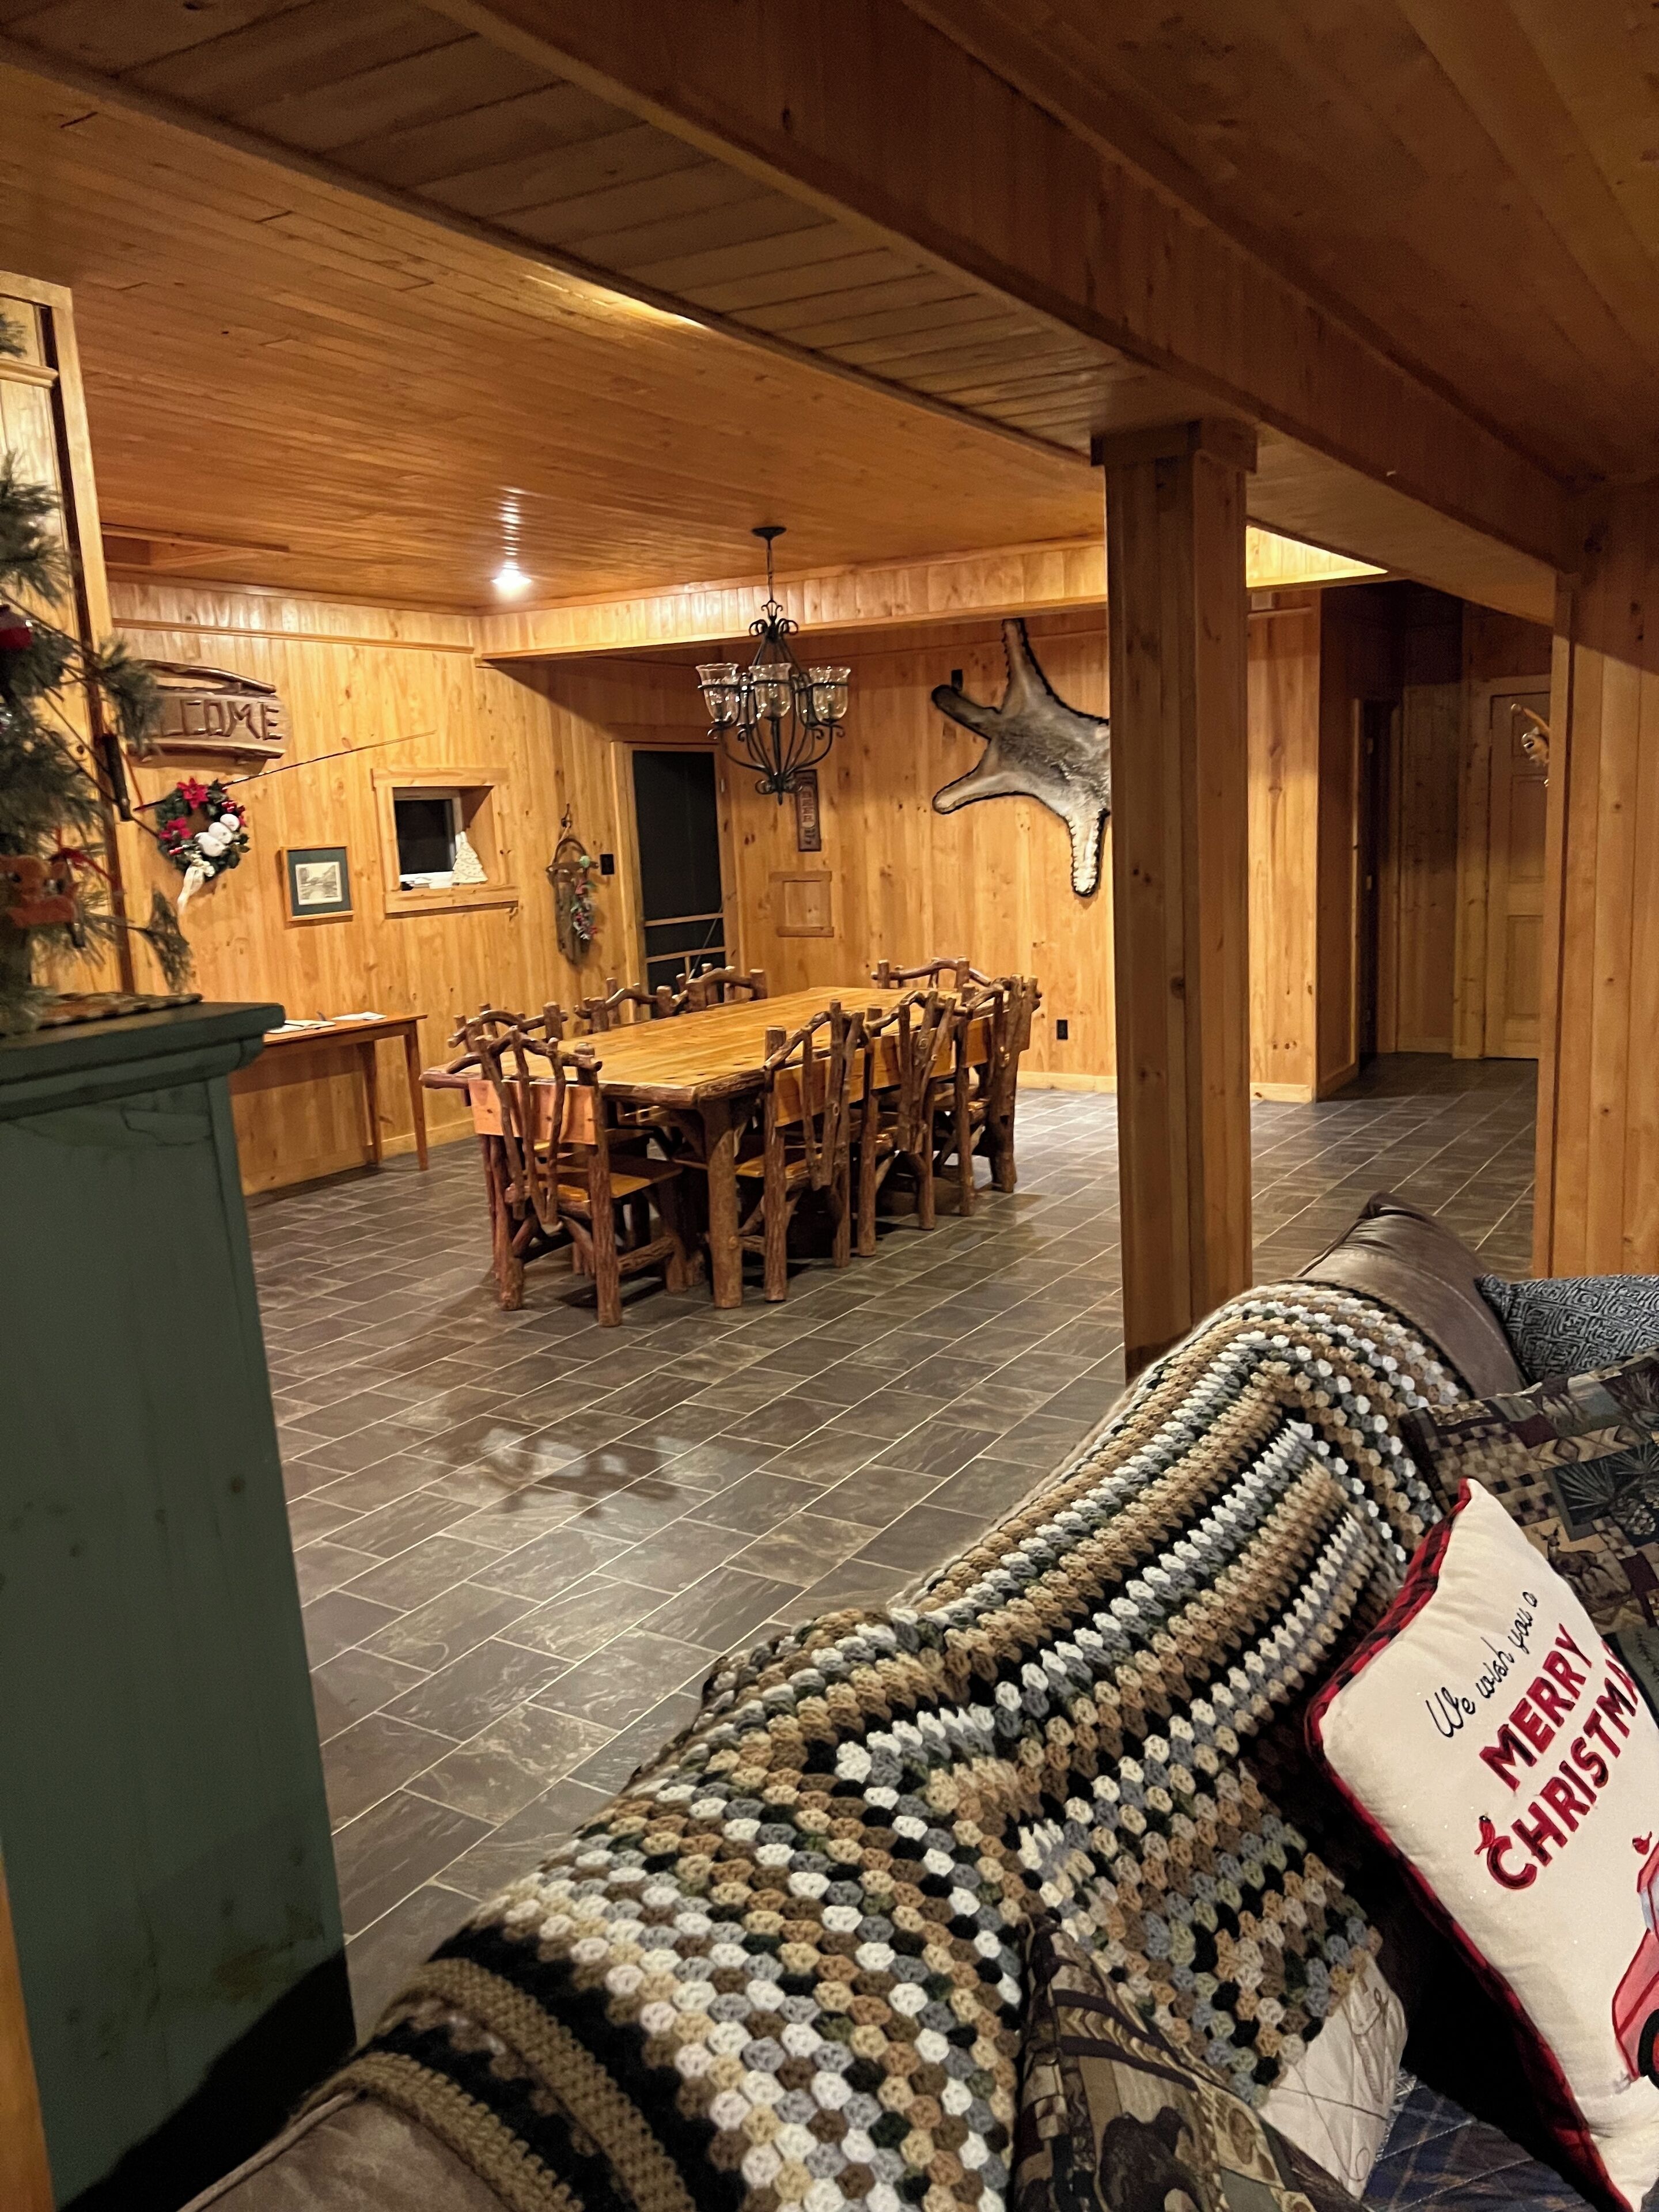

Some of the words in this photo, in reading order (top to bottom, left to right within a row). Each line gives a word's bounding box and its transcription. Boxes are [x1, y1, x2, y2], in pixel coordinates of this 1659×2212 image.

[1426, 1687, 1476, 1737] We
[1476, 1637, 1514, 1698] wish
[1508, 1608, 1533, 1654] you
[1522, 1592, 1539, 1607] a
[1479, 1623, 1592, 1791] MERRY
